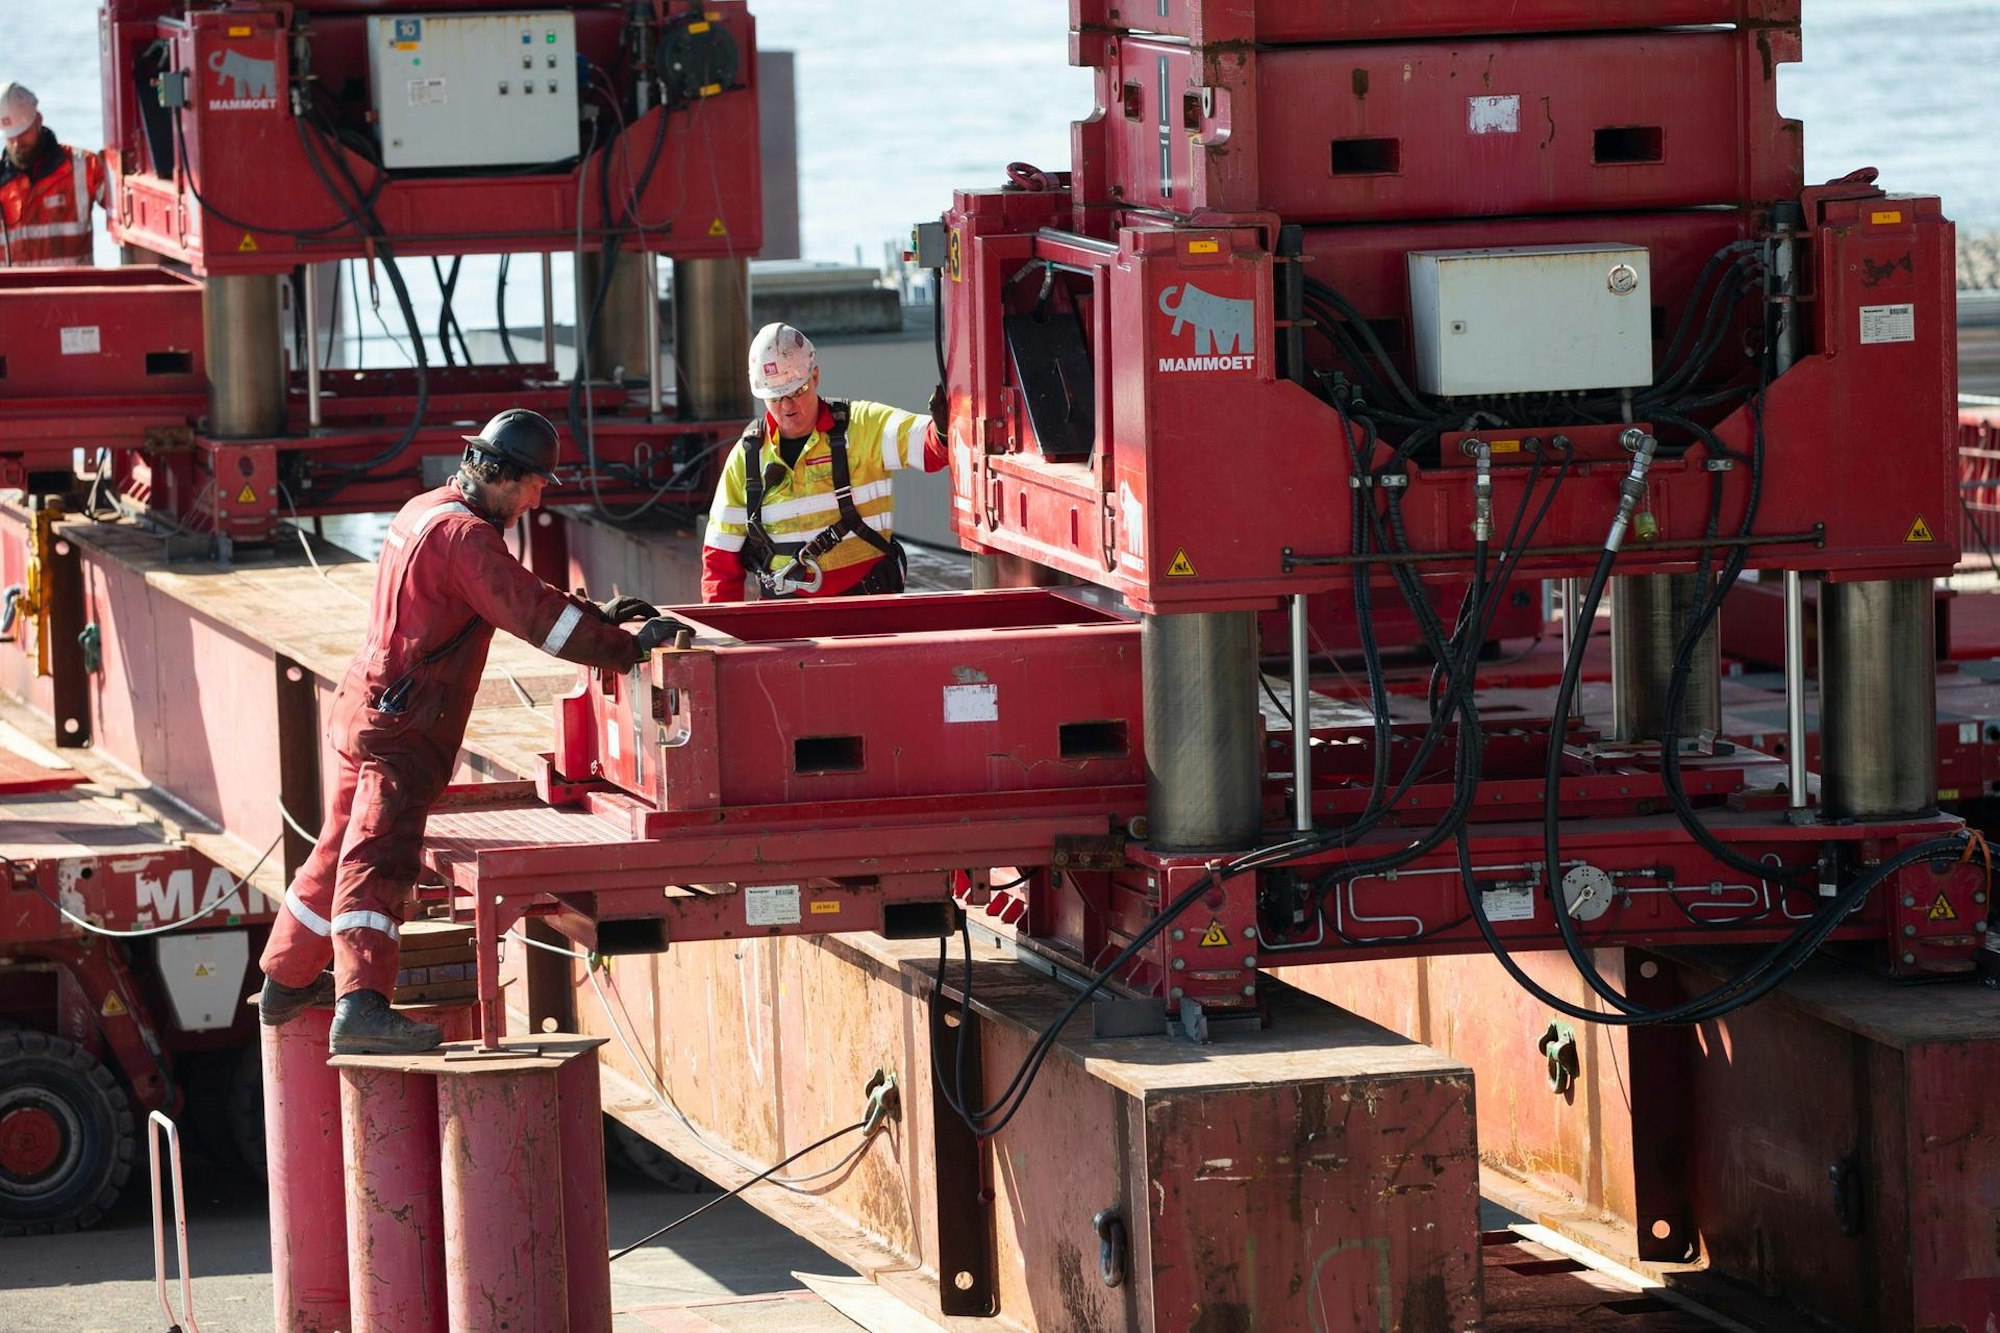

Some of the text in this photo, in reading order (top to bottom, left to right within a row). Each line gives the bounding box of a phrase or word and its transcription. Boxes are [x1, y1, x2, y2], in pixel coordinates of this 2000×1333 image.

[401, 22, 417, 37] 10
[209, 99, 277, 111] MAMMOET
[951, 232, 960, 278] 3
[1158, 355, 1254, 372] MAMMOET
